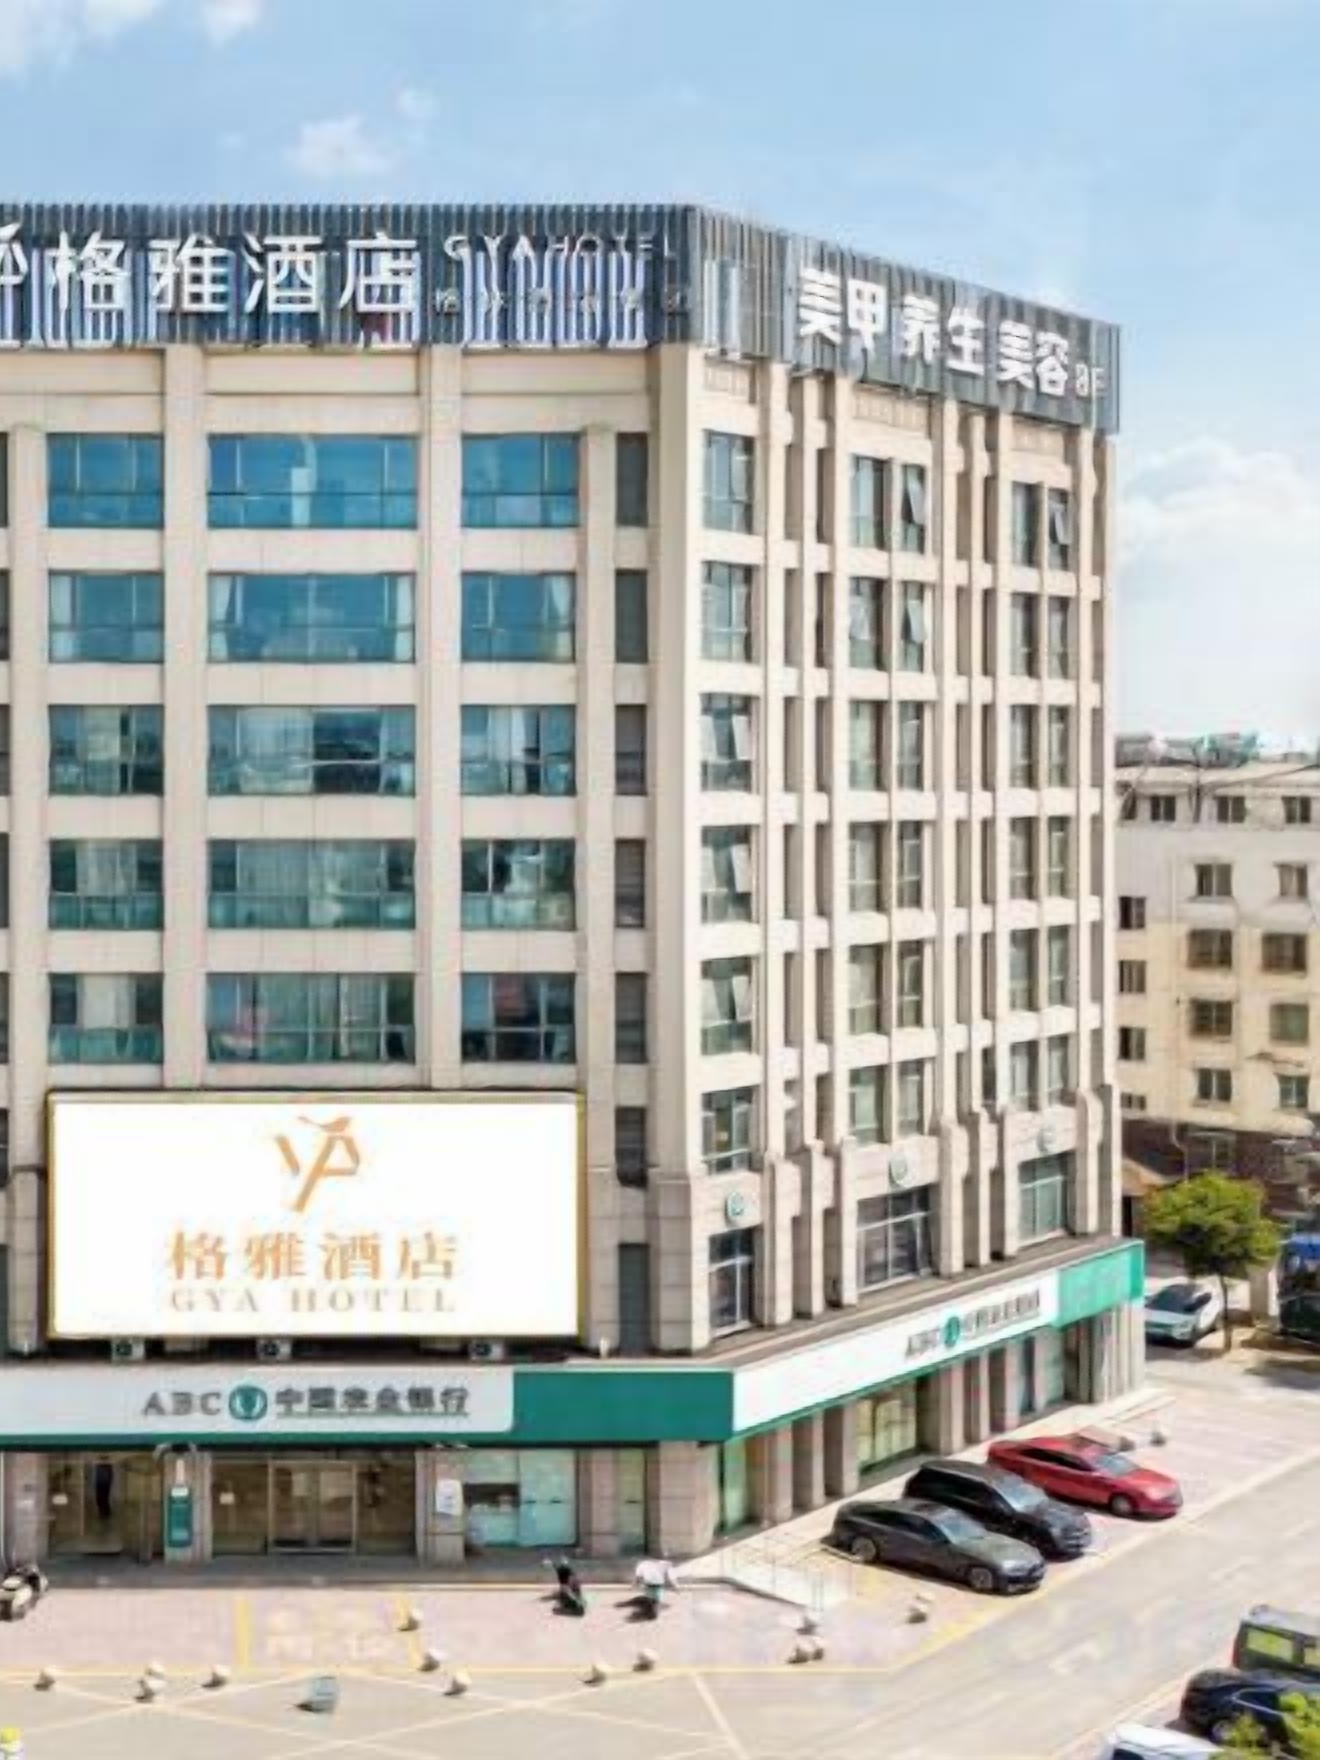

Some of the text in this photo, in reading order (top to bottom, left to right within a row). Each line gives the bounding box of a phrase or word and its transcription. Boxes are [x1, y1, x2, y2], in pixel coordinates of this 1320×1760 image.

[45, 231, 420, 314] 格雅酒店
[170, 1231, 458, 1281] 格雅酒店
[171, 1287, 457, 1313] GYA HOTEL
[142, 1390, 222, 1417] ABC
